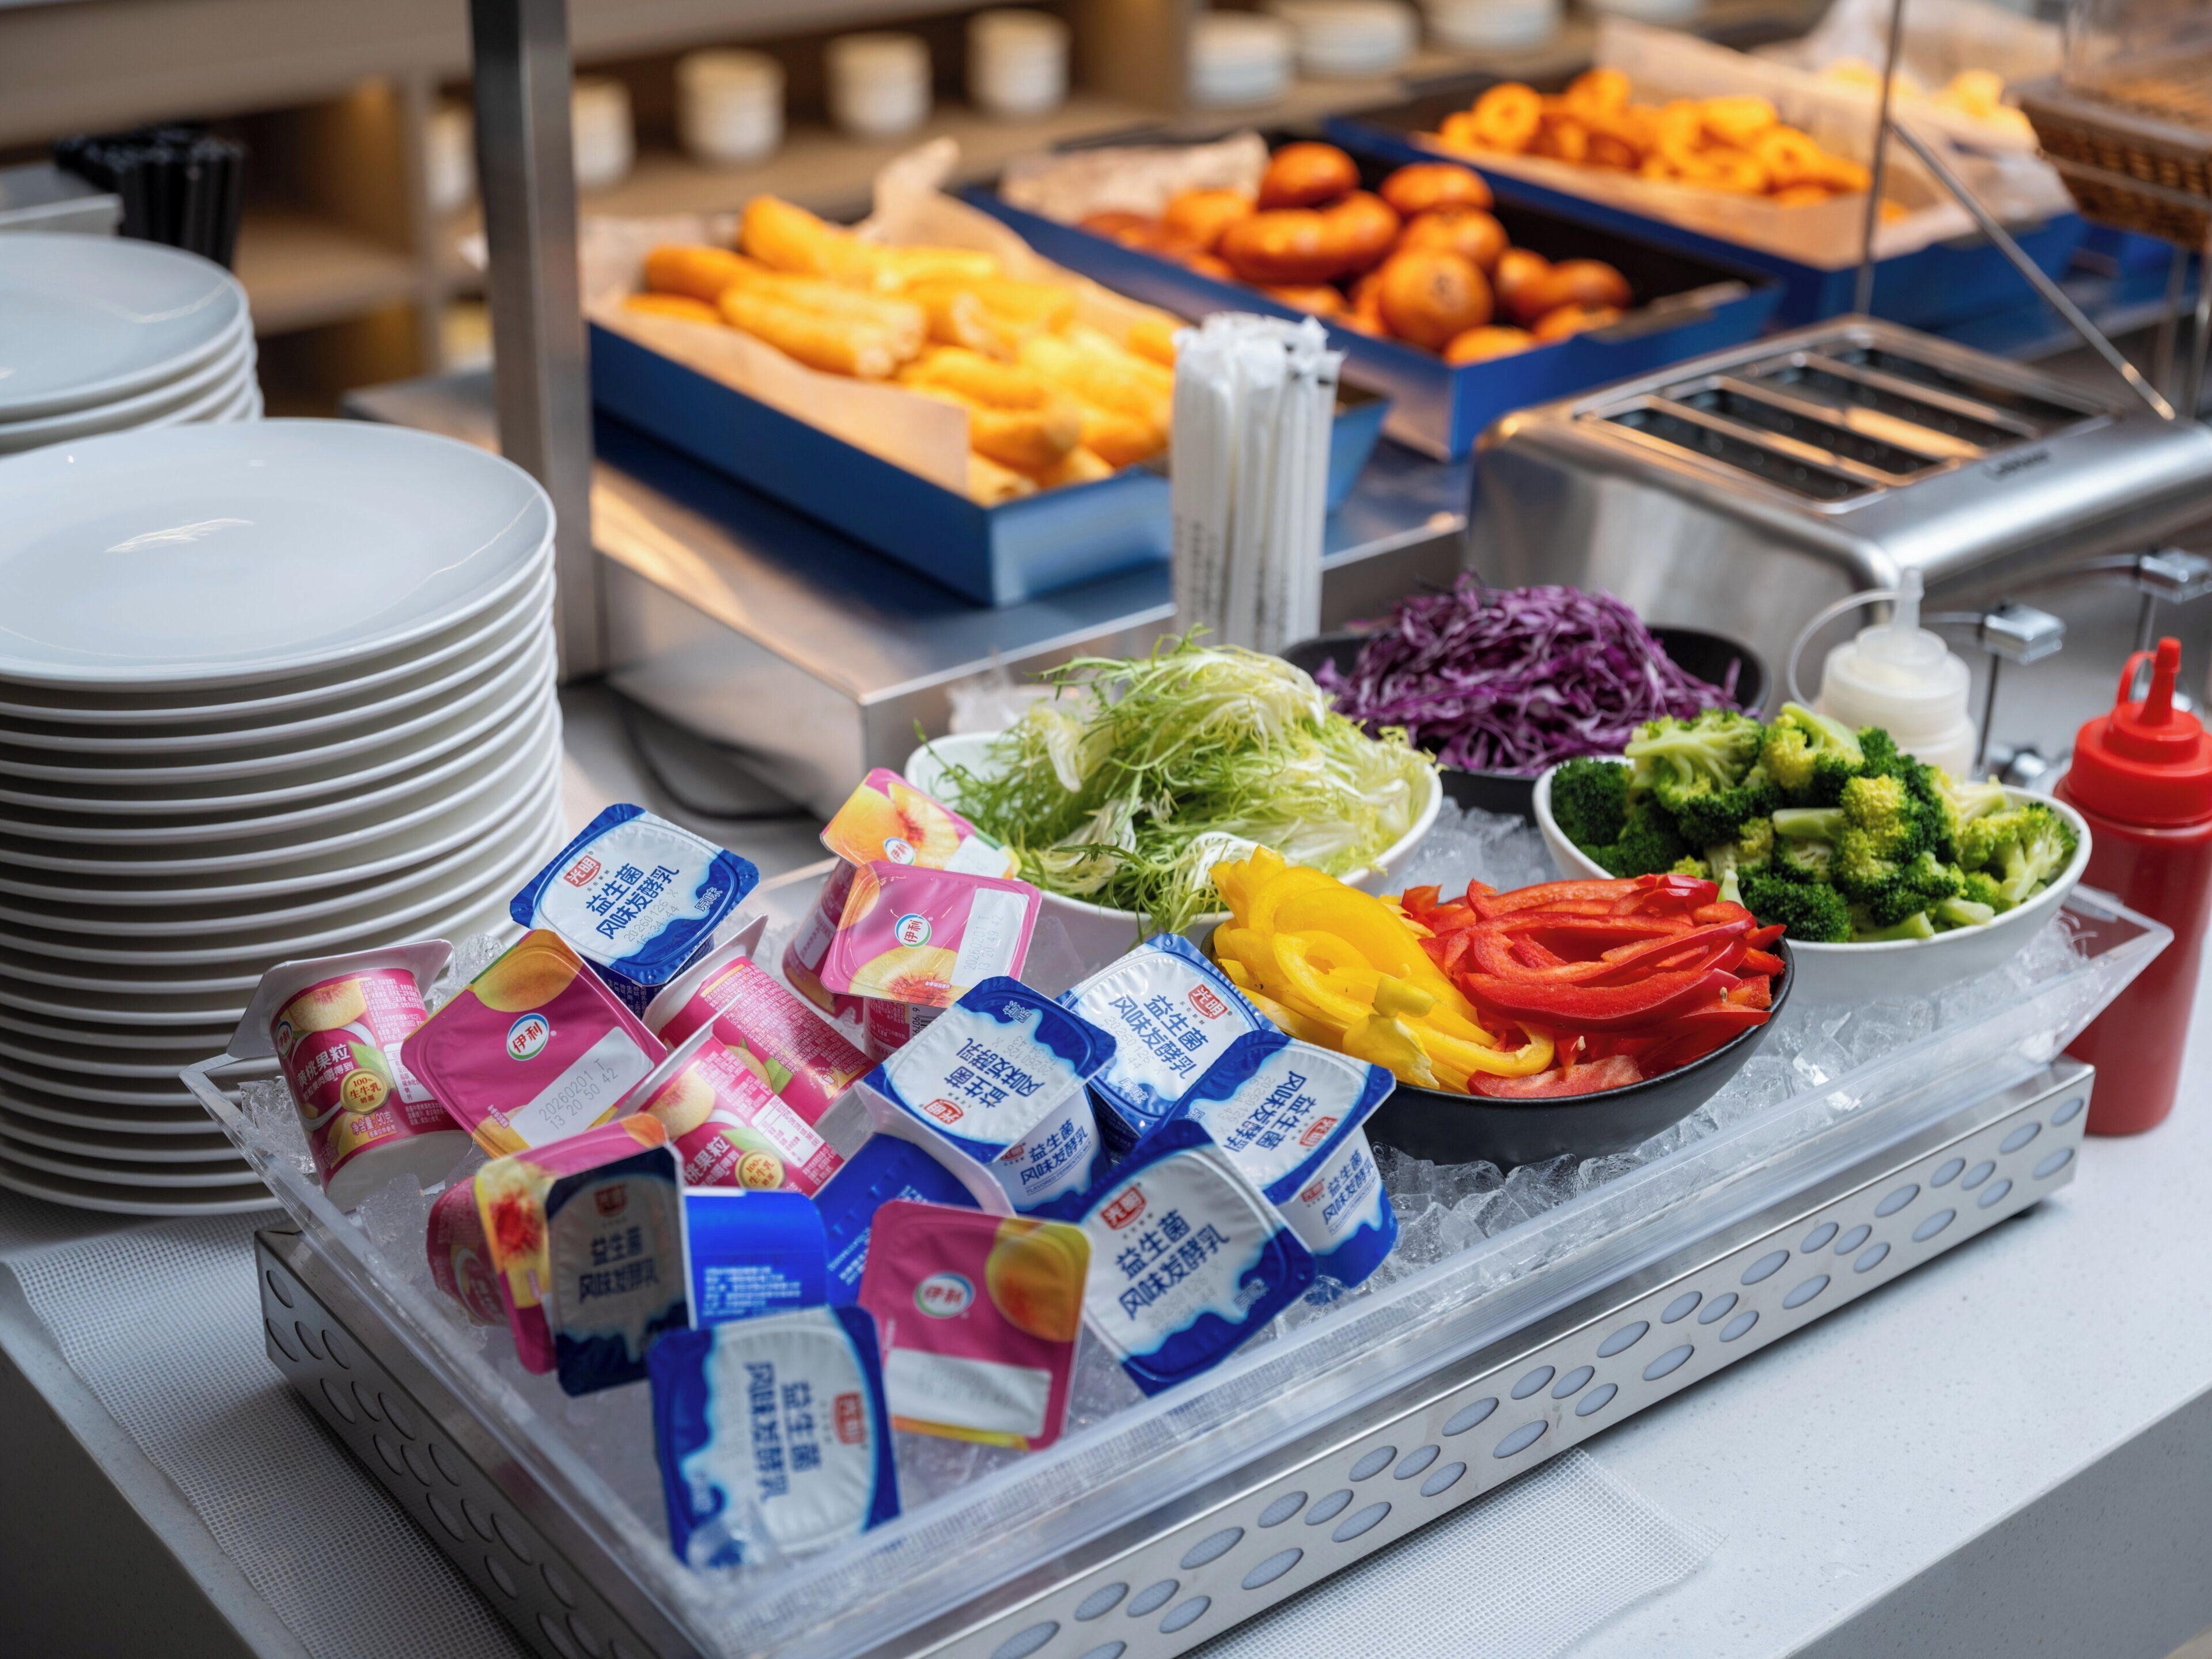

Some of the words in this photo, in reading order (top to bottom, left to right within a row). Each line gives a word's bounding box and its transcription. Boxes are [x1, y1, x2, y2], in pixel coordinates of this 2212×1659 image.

[567, 857, 597, 884] 光明
[586, 863, 645, 917] 益生菌
[596, 865, 680, 940] 风味发酵乳
[623, 899, 669, 942] 20260126
[694, 887, 723, 912] 原味
[904, 919, 923, 943] 伊利
[963, 926, 987, 971] 20260201
[1003, 1001, 1033, 1024] 原味
[1143, 995, 1209, 1052] 益生菌
[1192, 987, 1225, 1016] 光明
[512, 1021, 543, 1054] 伊利
[1108, 994, 1197, 1080] 风味发酵乳
[297, 1043, 350, 1089] 黄桃果粒
[353, 1077, 373, 1088] 100%
[944, 1066, 1010, 1108] 益生菌
[956, 1037, 1046, 1097] 风味发酵乳
[350, 1082, 381, 1100] 生牛乳
[359, 1094, 376, 1104] 奶源
[539, 1070, 594, 1122] 20260201
[593, 1058, 605, 1071] T
[550, 1115, 566, 1130] 13
[566, 1099, 582, 1116] 20
[583, 1083, 600, 1100] 50
[601, 1067, 618, 1084] 42
[1119, 1077, 1149, 1104] 原味
[1222, 1070, 1307, 1152] 风味发酵乳
[1028, 1118, 1074, 1164] 益生菌
[1255, 1094, 1317, 1151] 益生菌
[683, 1136, 730, 1185] 桃果粒
[1020, 1125, 1088, 1185] 风味发酵乳
[1328, 1148, 1362, 1199] 益生菌
[1026, 1175, 1056, 1194] FLAVORED
[1322, 1156, 1374, 1225] 风味发酵乳
[1101, 1187, 1146, 1230] 光明
[1116, 1208, 1191, 1281] 益生菌
[1118, 1223, 1230, 1321] 风味发酵乳
